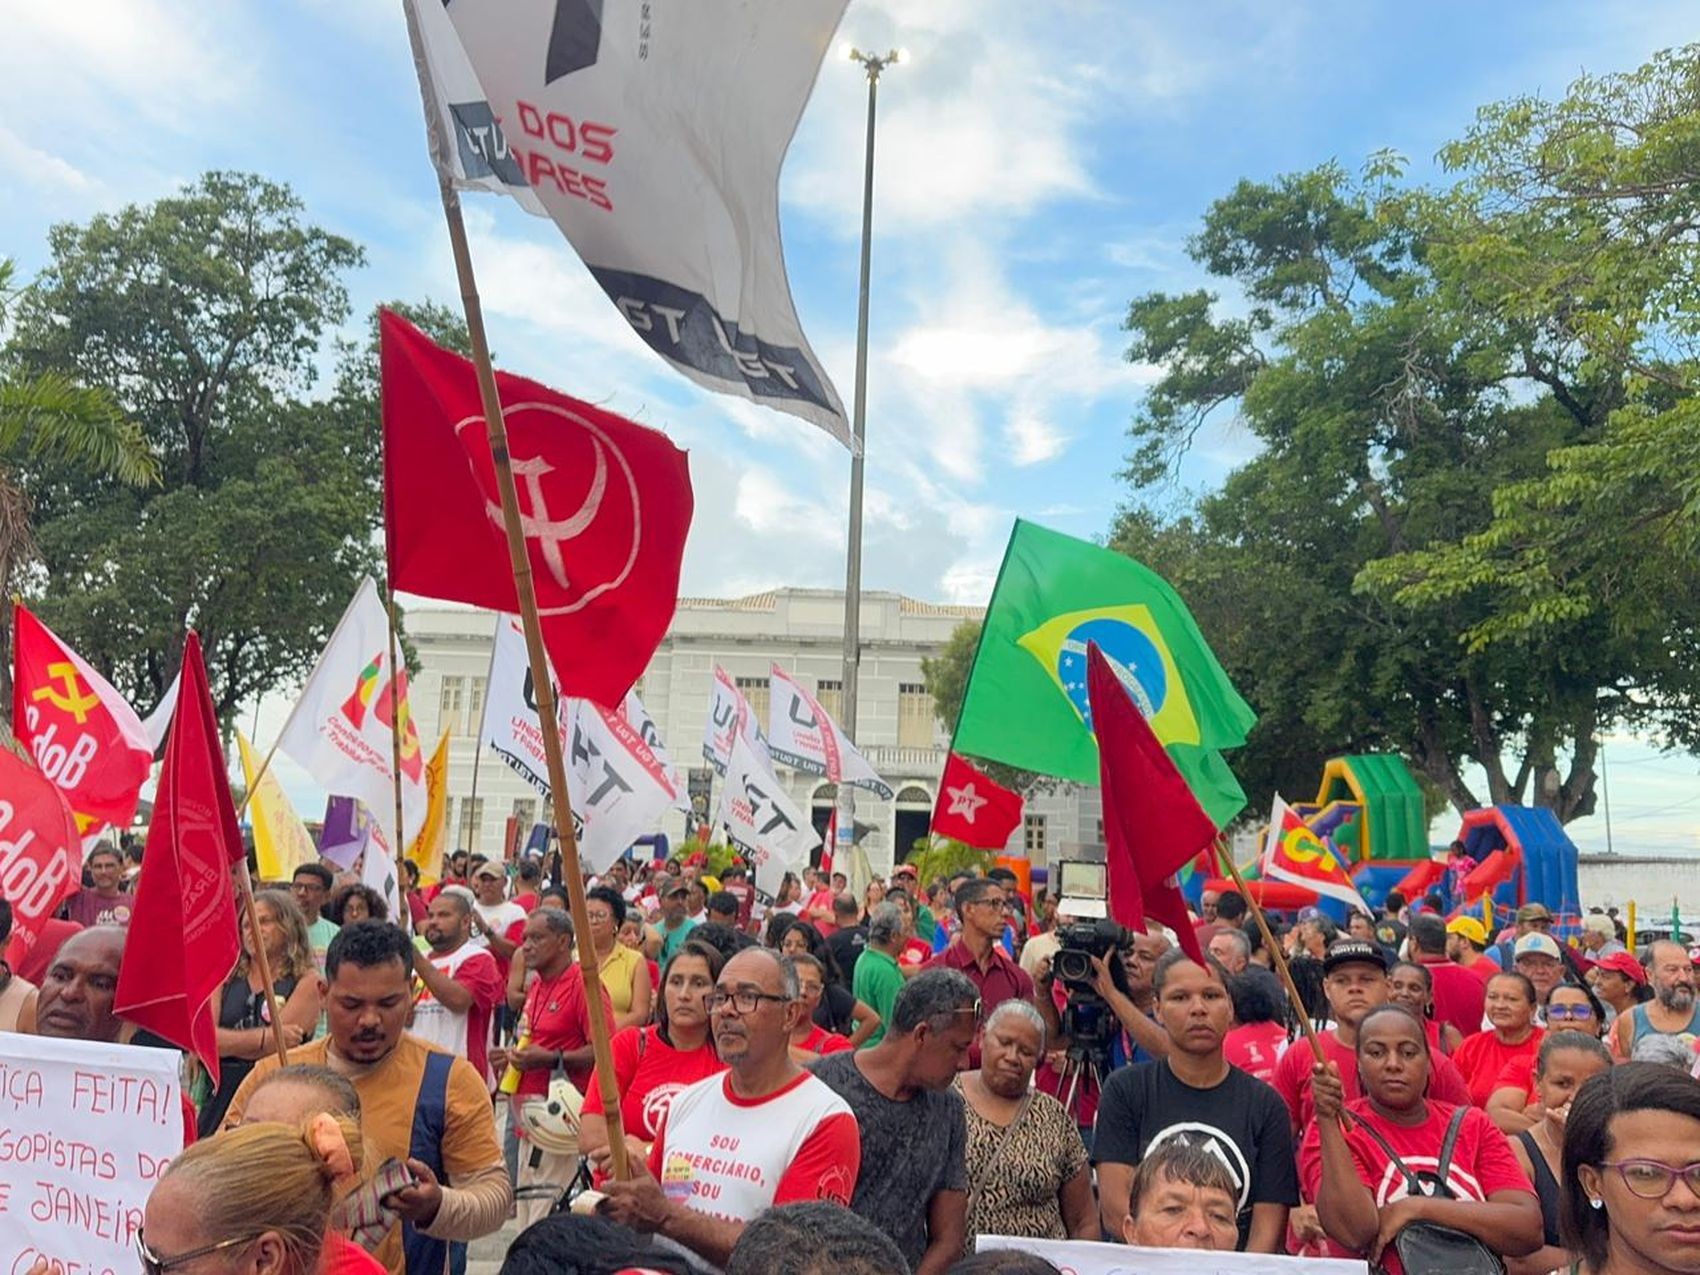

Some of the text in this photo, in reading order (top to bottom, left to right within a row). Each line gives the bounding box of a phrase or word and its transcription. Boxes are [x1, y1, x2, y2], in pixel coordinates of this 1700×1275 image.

[516, 99, 618, 165] DOS
[616, 295, 686, 345] GT
[957, 795, 976, 809] PT
[0, 1063, 43, 1111] IÇA
[709, 1134, 741, 1152] SOU
[671, 1150, 766, 1188] MERCIÁRIO,
[691, 1179, 722, 1201] SOU
[31, 1180, 145, 1248] JANEIR
